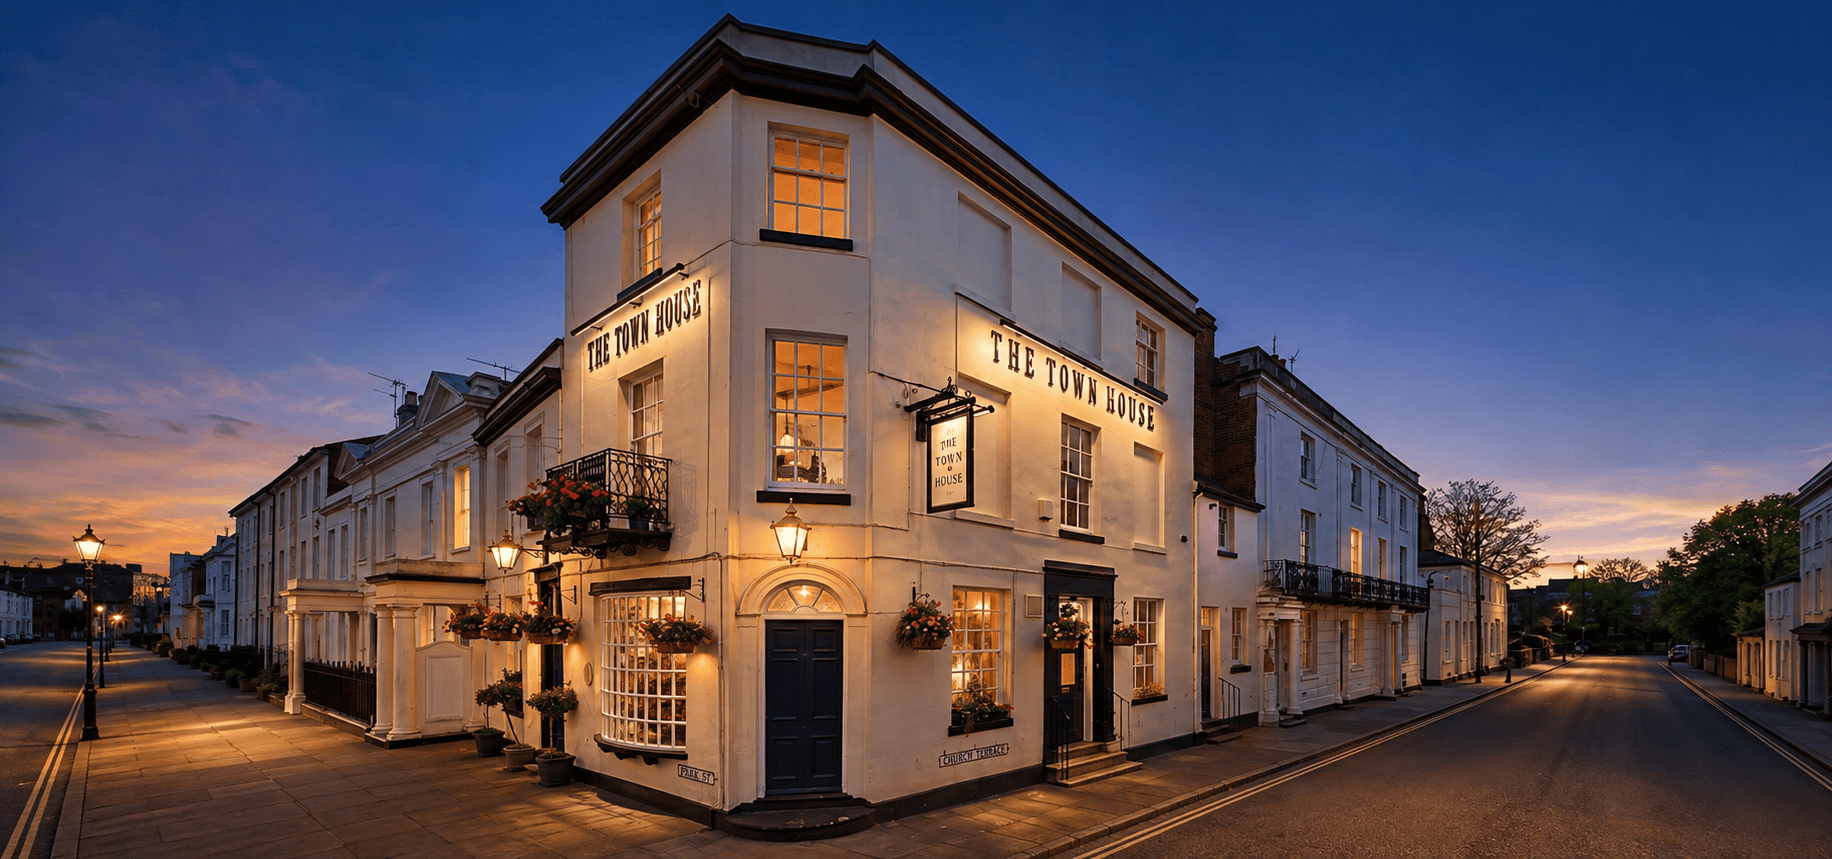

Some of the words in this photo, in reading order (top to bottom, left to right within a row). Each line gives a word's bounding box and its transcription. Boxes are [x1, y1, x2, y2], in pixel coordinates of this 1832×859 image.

[587, 332, 610, 371] THE
[615, 309, 649, 358] TOWN
[655, 279, 701, 337] HOUSE
[991, 330, 1034, 379] THE
[1046, 357, 1097, 406] TOWN
[1106, 385, 1155, 431] HOUSE
[940, 437, 957, 451] THE
[935, 451, 962, 467] TOWN
[935, 473, 963, 488] HOUSE
